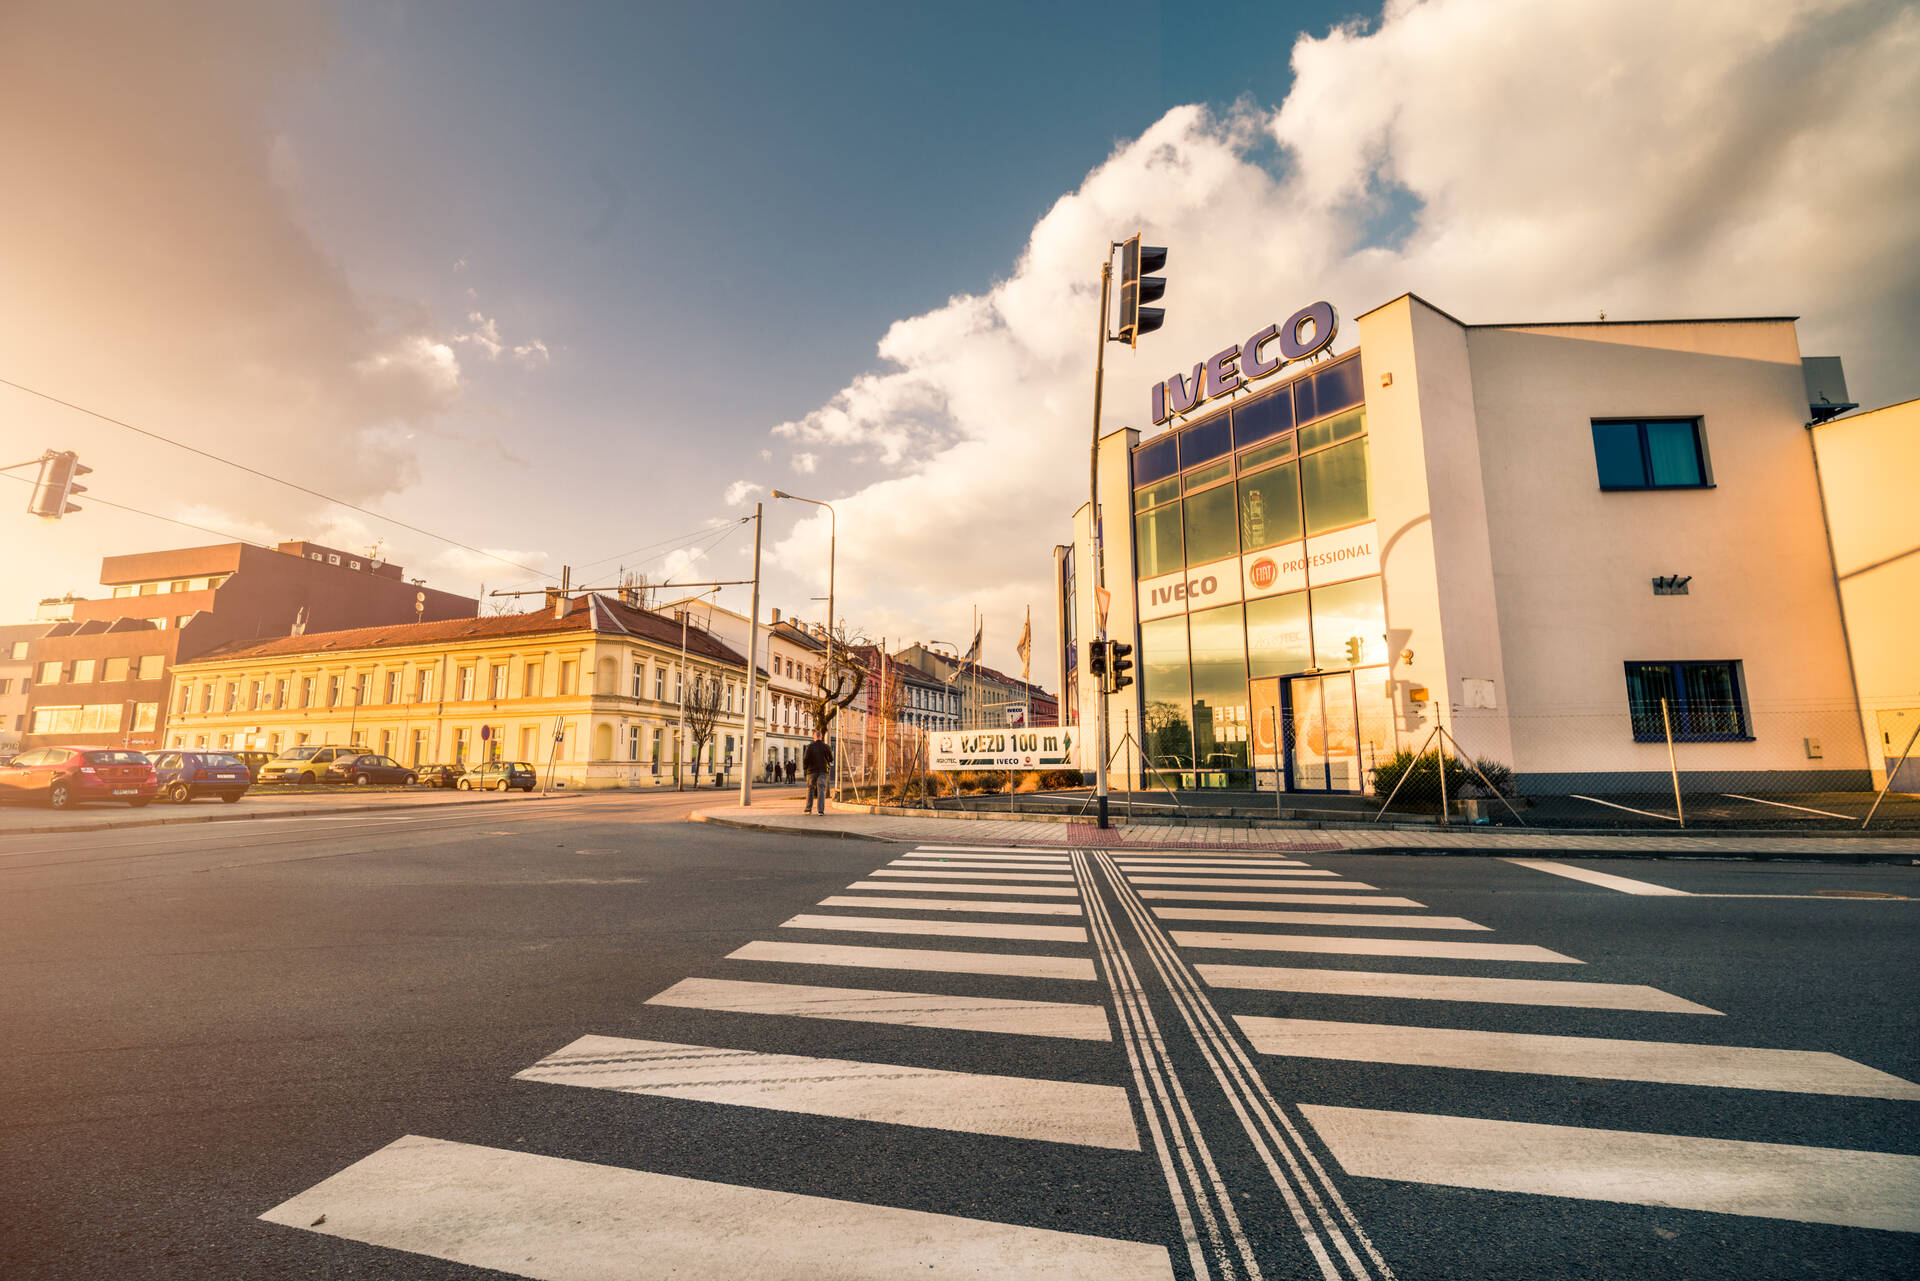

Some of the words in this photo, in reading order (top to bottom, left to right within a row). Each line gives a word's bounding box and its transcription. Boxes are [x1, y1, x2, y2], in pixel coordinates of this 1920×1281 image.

[1151, 301, 1339, 426] IVECO
[1255, 565, 1272, 582] FIAT
[1282, 543, 1372, 574] PROFESSIONAL
[1151, 575, 1218, 606] IVECO
[961, 734, 1005, 753] VJEZD
[1011, 733, 1037, 752] 100
[1043, 735, 1058, 751] m
